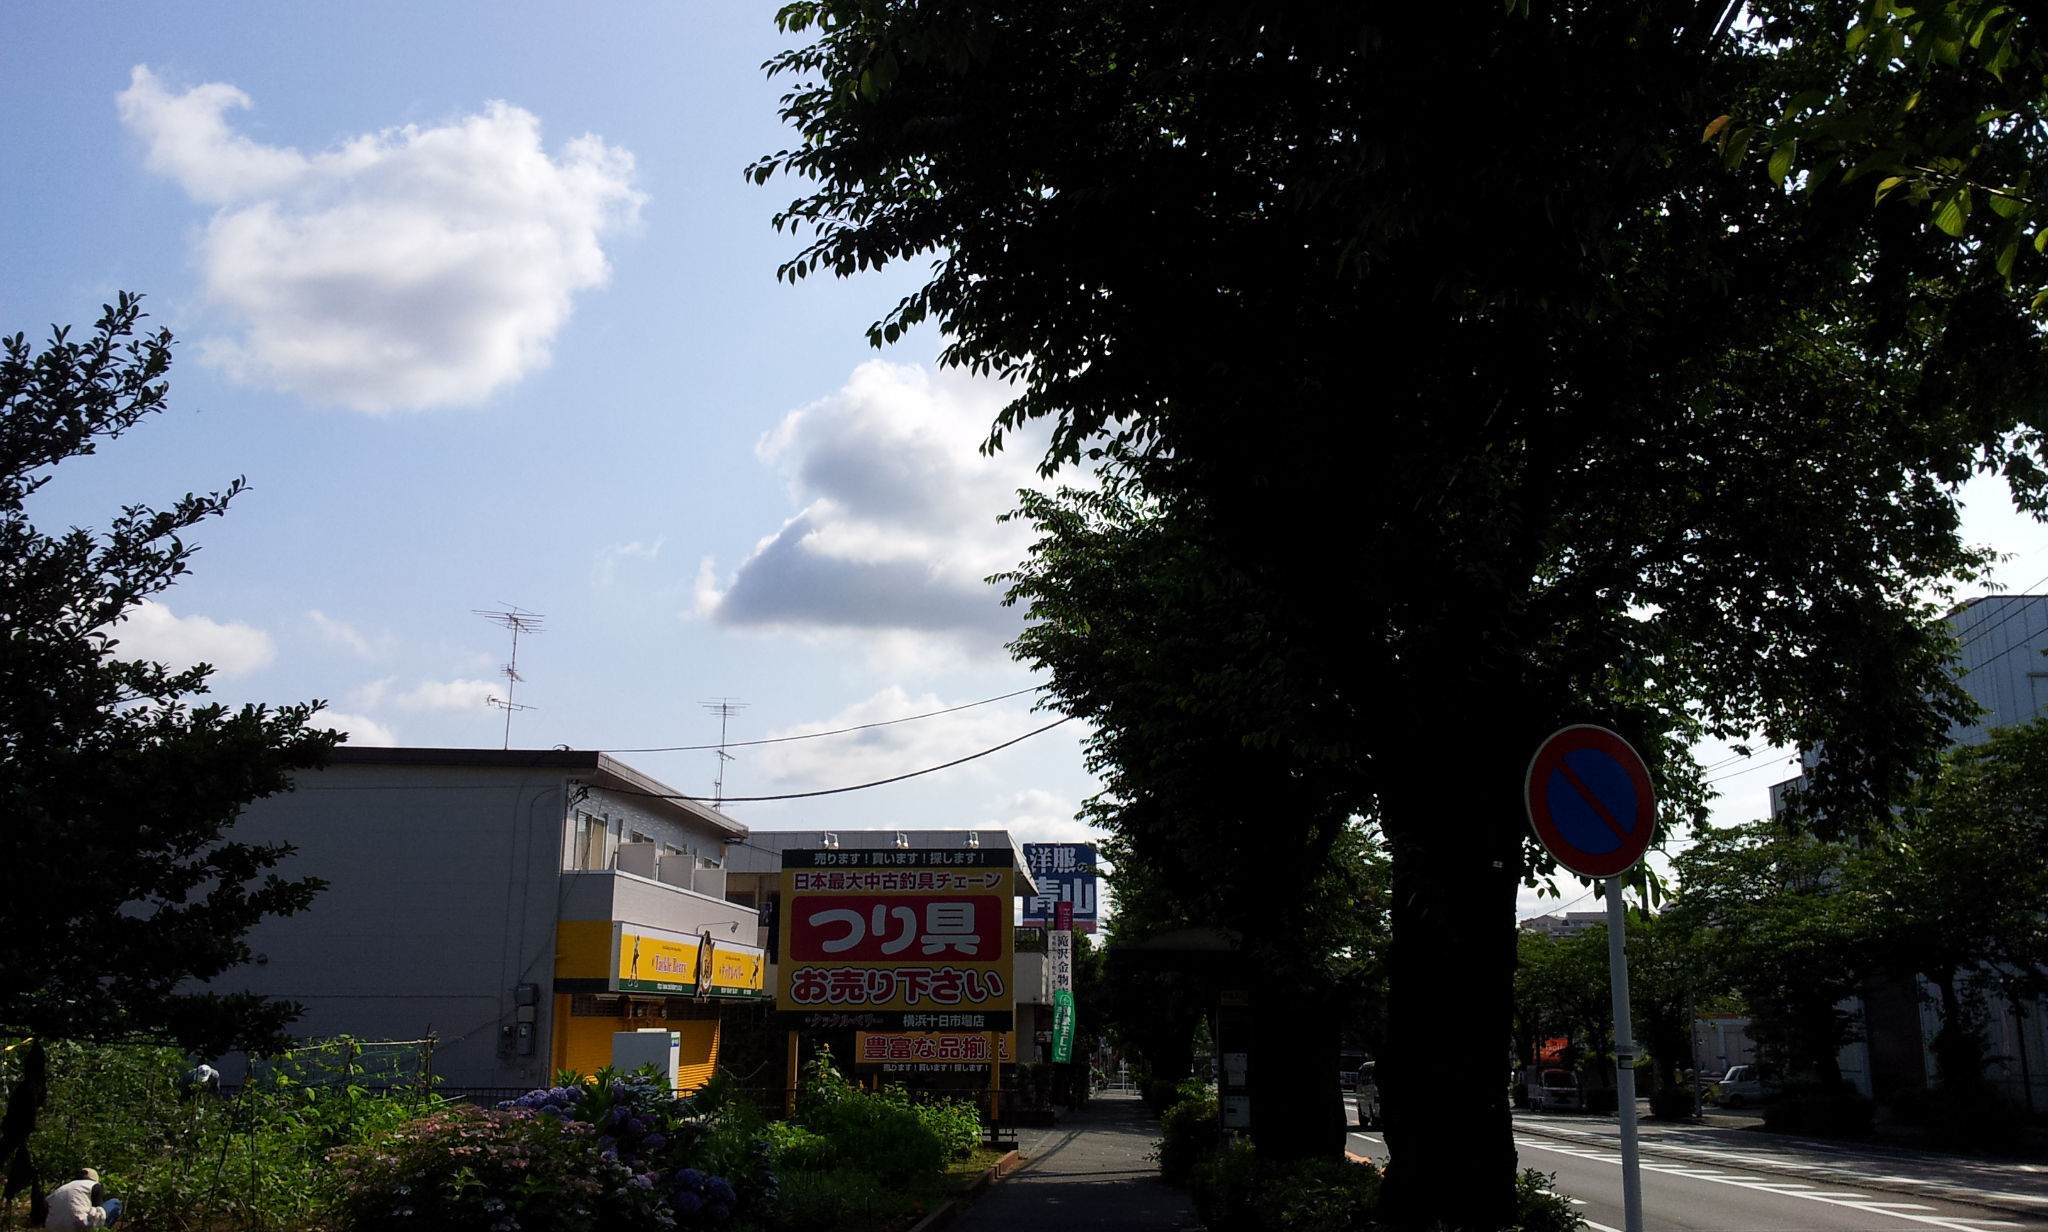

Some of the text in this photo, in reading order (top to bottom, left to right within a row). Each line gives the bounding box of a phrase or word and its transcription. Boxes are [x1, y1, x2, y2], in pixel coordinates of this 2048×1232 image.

[814, 852, 984, 865] 売ります！買います！探します！
[1030, 847, 1088, 874] 洋服の
[794, 871, 1002, 891] 日本最大中古釣具チェーン
[1030, 876, 1093, 914] 青山
[809, 903, 980, 954] つり具
[1058, 935, 1069, 993] 滝沢金物
[791, 966, 1004, 1004] お売り下さい
[903, 1014, 985, 1027] 横浜十日市場店
[864, 1036, 1010, 1060] 豊富な品揃え
